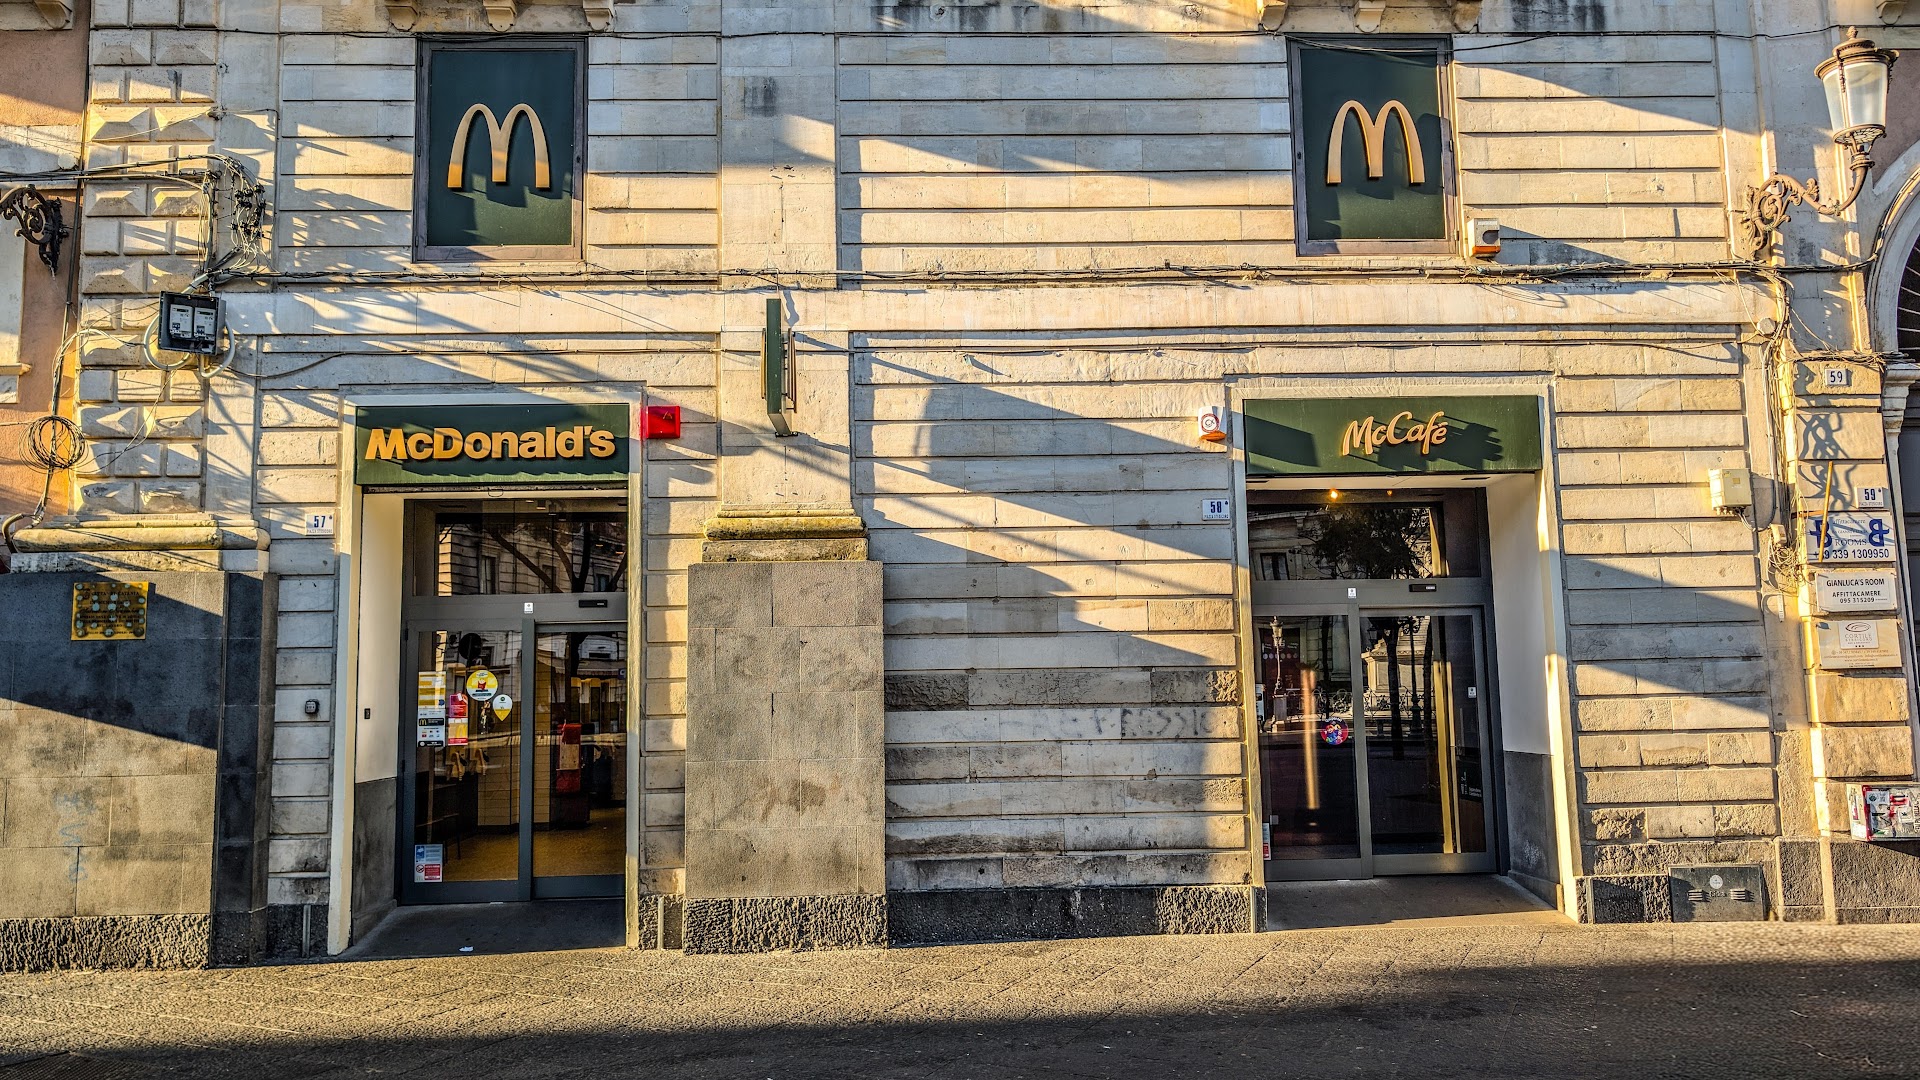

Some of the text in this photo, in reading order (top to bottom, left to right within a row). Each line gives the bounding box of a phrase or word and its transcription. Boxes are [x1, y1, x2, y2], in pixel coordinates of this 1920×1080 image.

[1830, 370, 1843, 383] 59
[1342, 411, 1448, 456] McCafé
[364, 426, 616, 460] McDonald's
[1864, 488, 1876, 501] 59
[1210, 501, 1222, 513] 58
[314, 515, 326, 528] 57
[1835, 538, 1867, 547] ROOMS
[1832, 549, 1849, 559] 339
[1852, 548, 1890, 559] 1309950
[1826, 578, 1885, 587] GIANLUCA'S ROOM
[1832, 590, 1881, 598] AFFITTACAMERE
